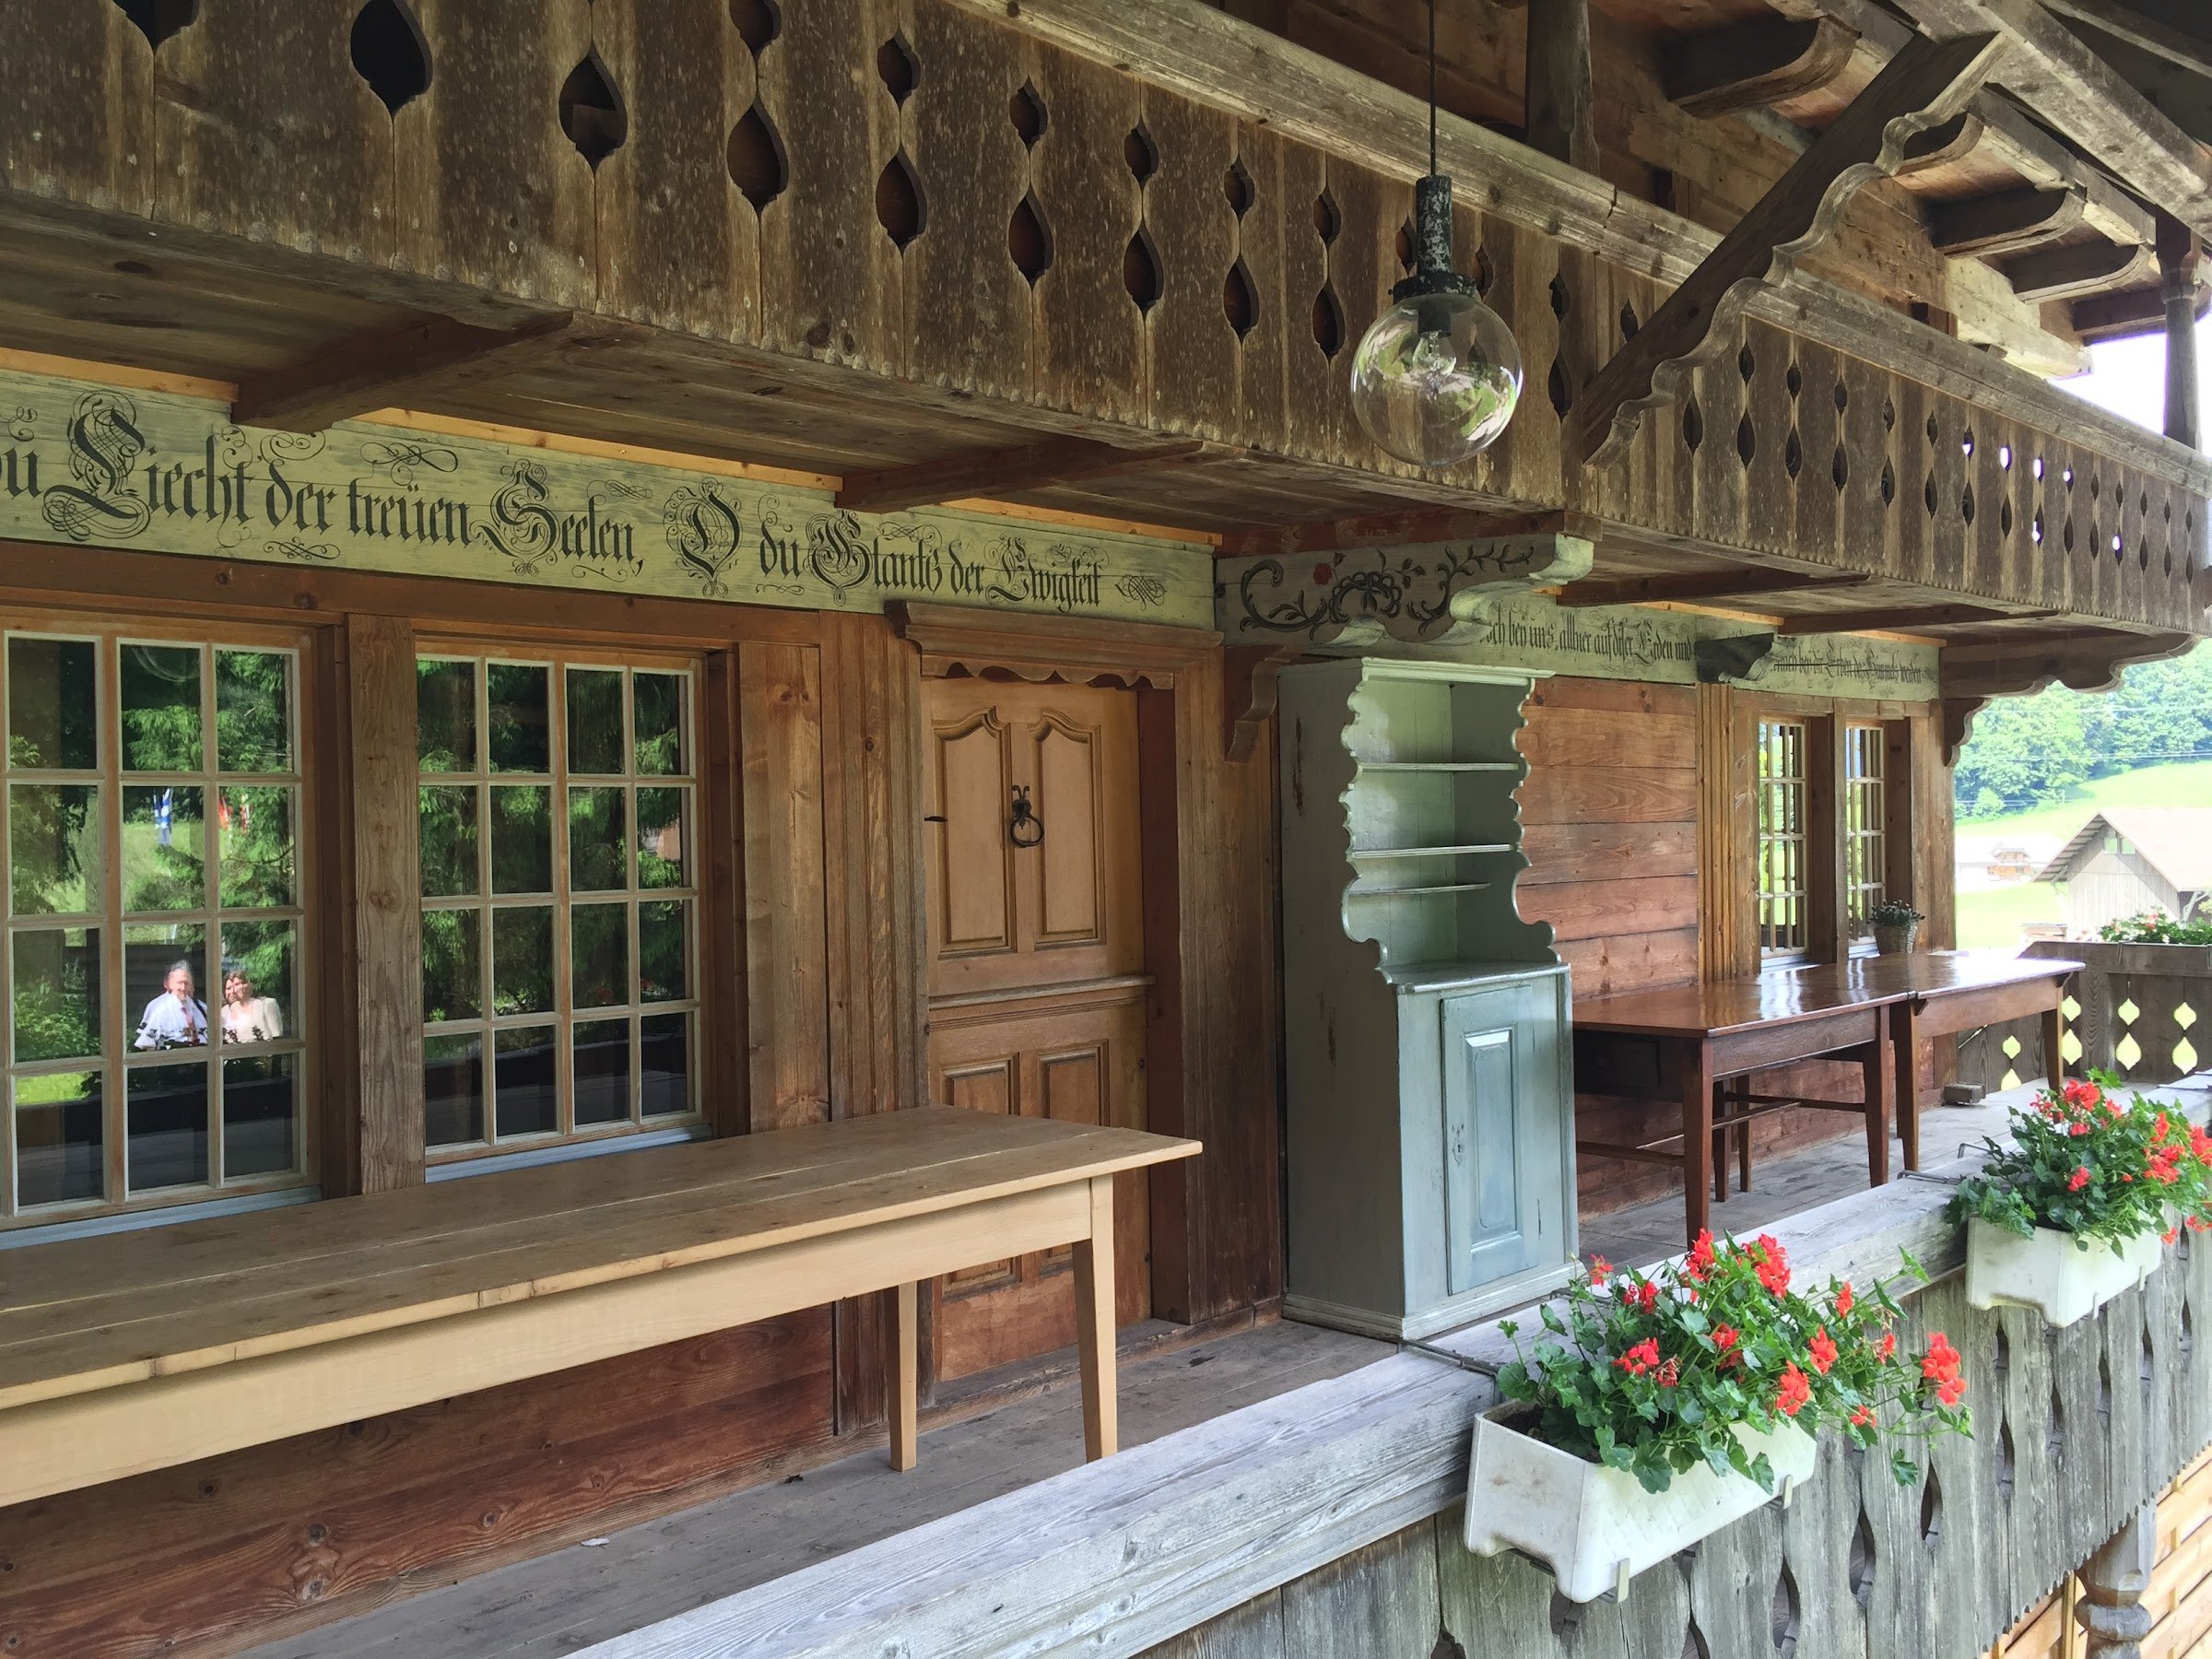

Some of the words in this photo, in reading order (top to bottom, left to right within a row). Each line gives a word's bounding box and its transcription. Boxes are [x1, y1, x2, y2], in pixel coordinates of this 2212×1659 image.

[0, 447, 44, 500] u
[265, 459, 337, 535] der
[948, 540, 987, 597] der
[984, 536, 1103, 613] Ewigkeit
